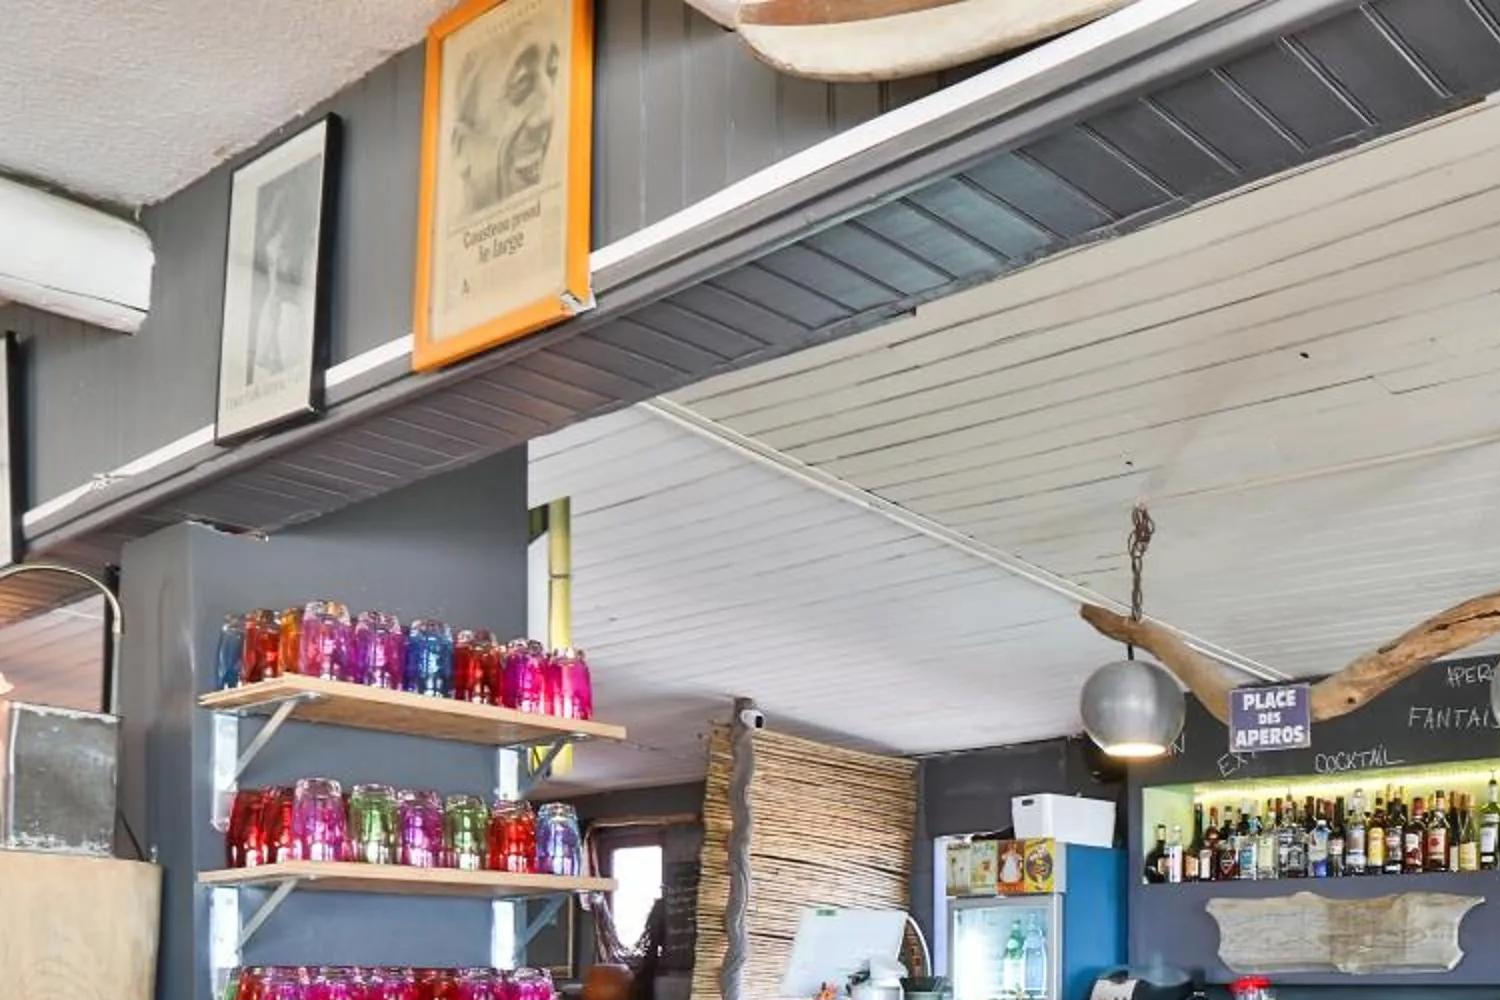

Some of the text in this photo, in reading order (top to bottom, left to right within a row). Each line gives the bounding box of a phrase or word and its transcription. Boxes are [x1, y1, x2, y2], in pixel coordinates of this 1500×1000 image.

[479, 231, 525, 263] le large
[1447, 663, 1497, 688] APER
[1243, 689, 1296, 711] PLACE
[1258, 711, 1281, 725] DES
[1235, 726, 1305, 747] APEROS
[1315, 744, 1404, 773] COCKTAIL
